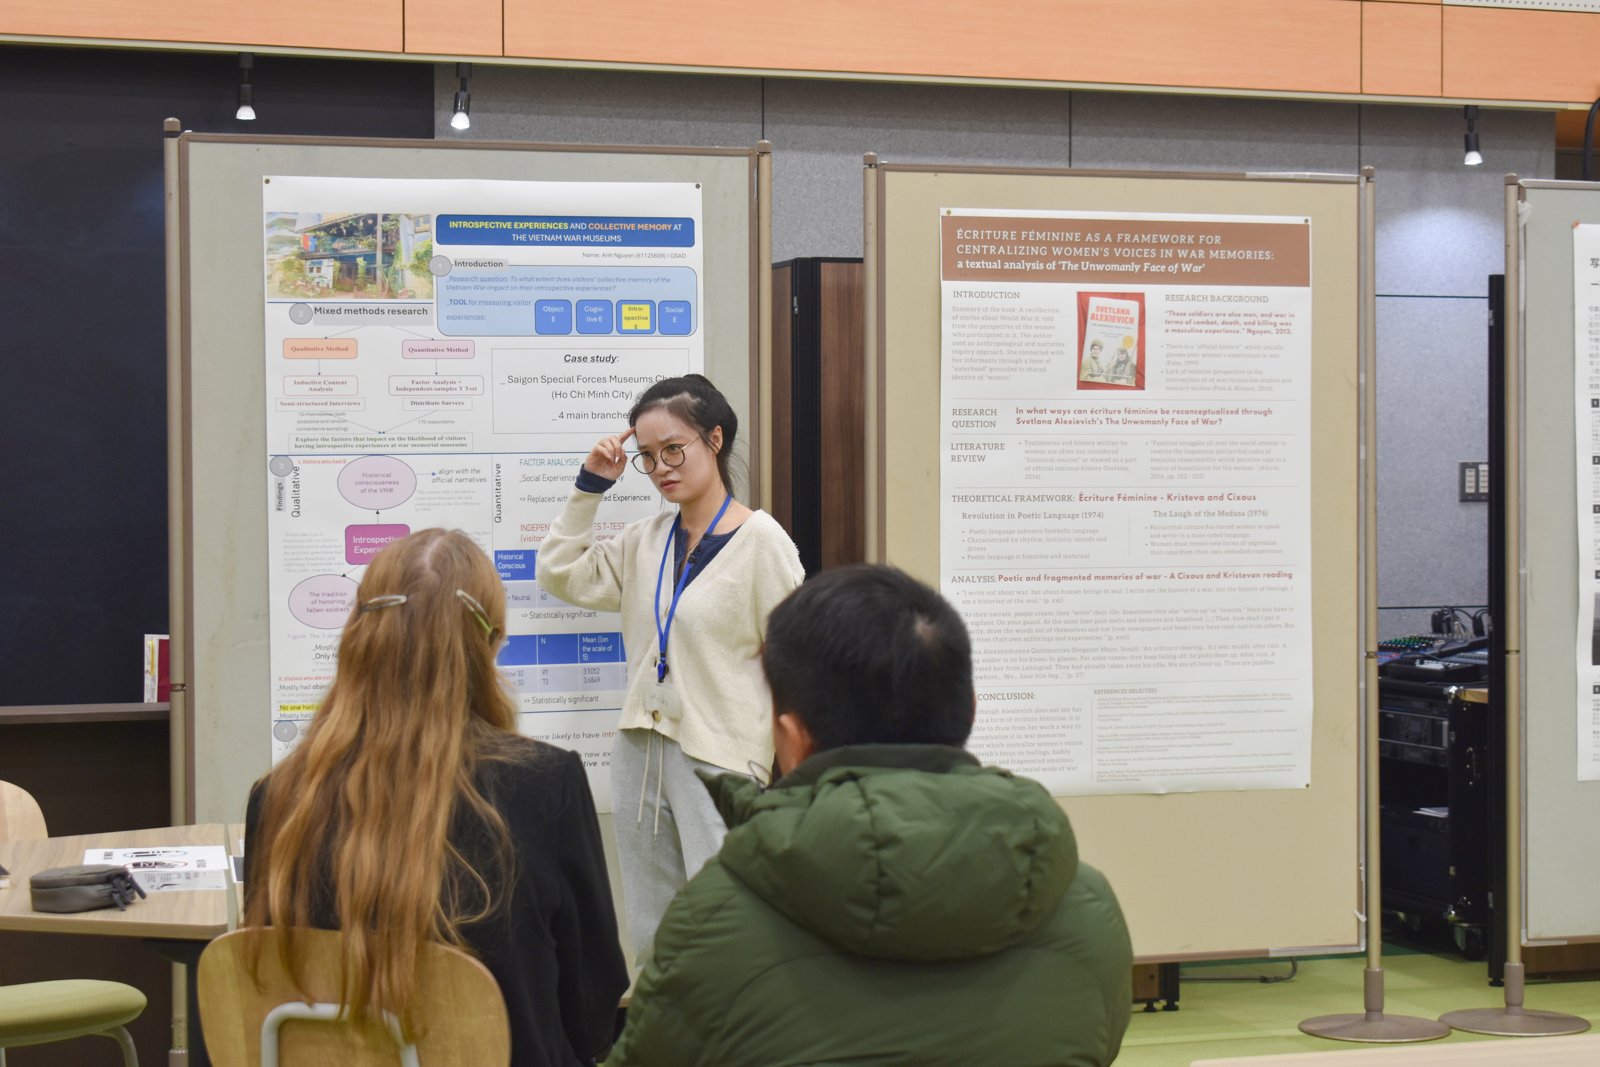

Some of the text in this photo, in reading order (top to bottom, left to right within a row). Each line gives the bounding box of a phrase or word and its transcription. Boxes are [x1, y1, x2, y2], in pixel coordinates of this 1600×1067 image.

[449, 221, 512, 229] INTROSPECTIVE
[514, 222, 569, 230] EXPERIENCES
[528, 234, 562, 242] VIETNAM
[563, 234, 582, 242] WAR
[956, 229, 1222, 245] ÉCRITURE FÉMININE AS A FRAMEWORK FOR
[956, 244, 1274, 260] CENTRALIZING WOMEN'S VOICES IN WAR MEMORIES:
[965, 260, 1001, 269] textual
[1004, 260, 1044, 271] analysis
[1046, 260, 1056, 270] of
[1058, 261, 1079, 270] 'The
[1081, 262, 1141, 273] Unwomanly
[1143, 262, 1166, 272] Face
[1168, 263, 1179, 274] of
[1181, 263, 1205, 273] War'
[953, 291, 1020, 299] INTRODUCTION
[1165, 294, 1269, 303] RESEARCH BACKGROUND
[314, 307, 342, 315] Mixed
[624, 314, 648, 323] spective
[564, 354, 619, 364] Case study:
[507, 375, 654, 385] Saigon Special Forces Museums
[551, 390, 633, 400] (Ho Chi Minh City)
[952, 408, 997, 416] RESEARCH
[1241, 408, 1272, 417] through
[952, 420, 996, 428] QUESTION
[1016, 417, 1053, 425] Svetlana
[1121, 418, 1169, 426] Unwomanly
[520, 458, 580, 467] FACTOR ANALYSIS
[437, 468, 454, 476] align
[432, 475, 454, 483] official
[291, 466, 300, 517] Qualitative
[527, 495, 556, 503] Replaced
[612, 493, 651, 502] Experiences
[952, 493, 1256, 503] THEORETICAL FRAMEWORK: Écriture Féminine Kristeva and Cixous
[603, 522, 625, 530] T-TEST
[998, 574, 1024, 582] Poetic
[1043, 574, 1092, 582] fragmented
[1135, 572, 1144, 580] of
[1206, 571, 1221, 579] and
[1222, 571, 1261, 579] Kristevan
[1262, 571, 1293, 580] reading
[530, 609, 597, 621] Statistically significant
[568, 695, 599, 704] significant
[977, 692, 1036, 701] CONCLUSION:
[552, 731, 571, 740] likely
